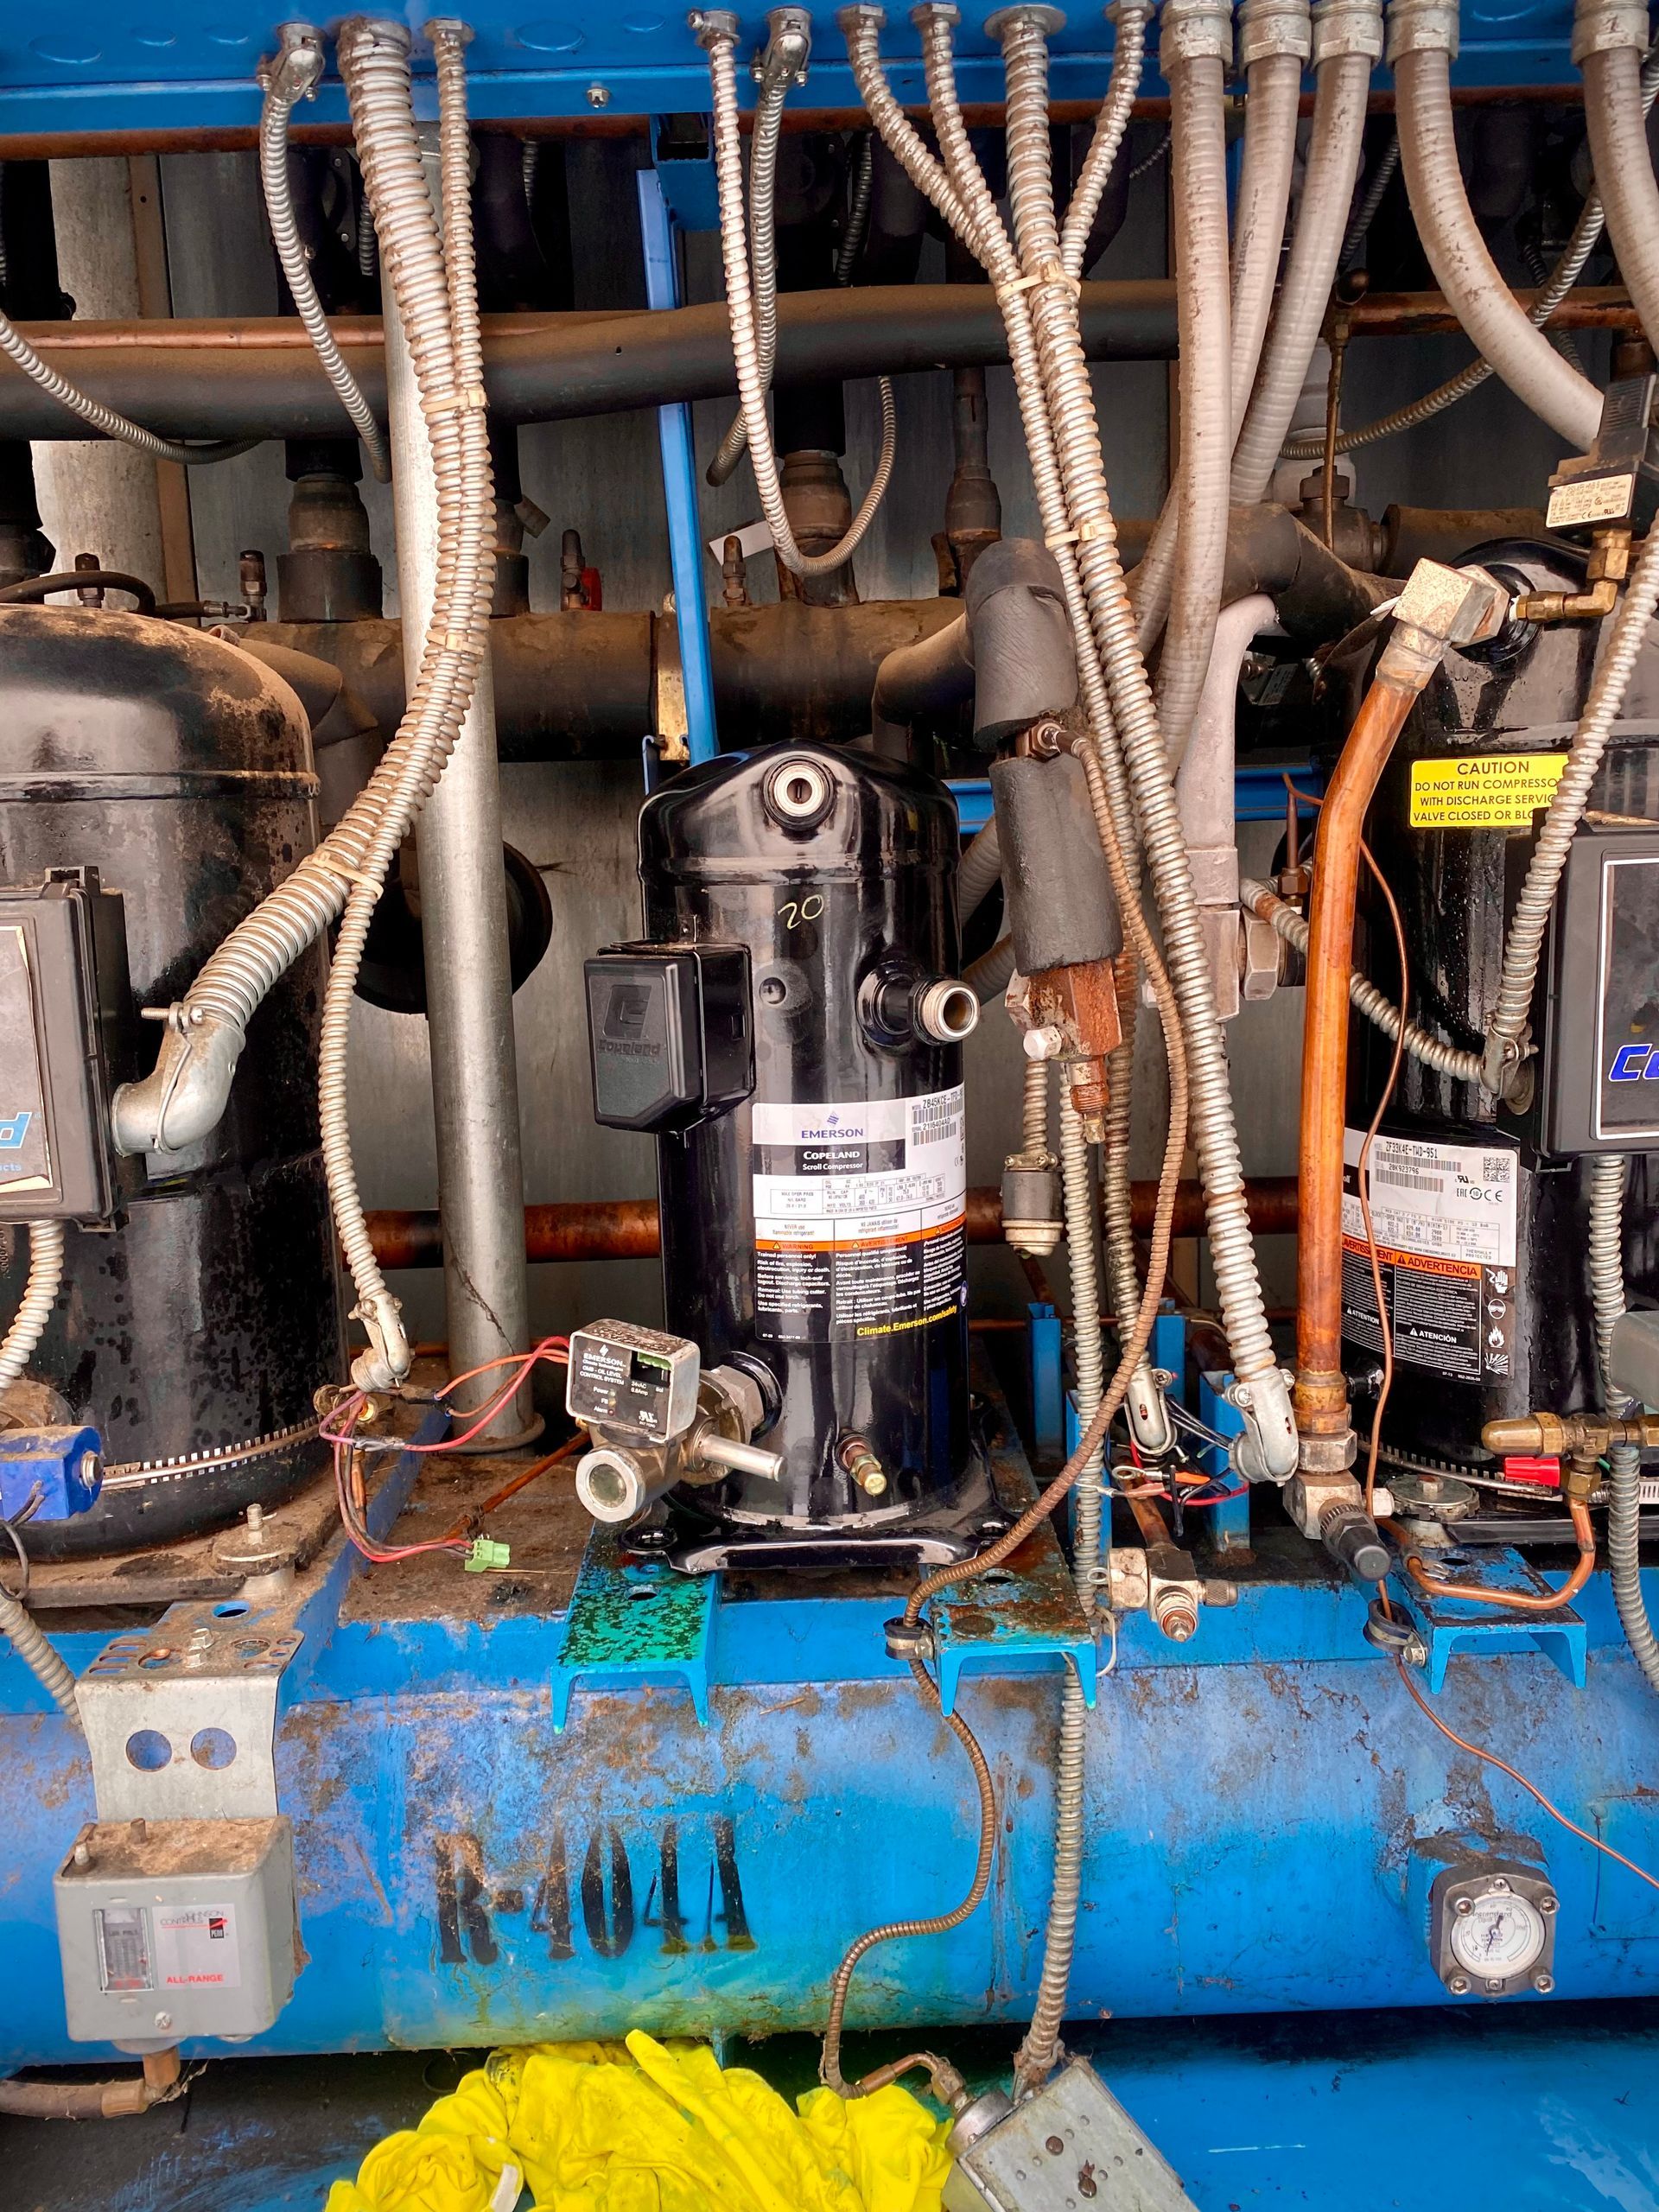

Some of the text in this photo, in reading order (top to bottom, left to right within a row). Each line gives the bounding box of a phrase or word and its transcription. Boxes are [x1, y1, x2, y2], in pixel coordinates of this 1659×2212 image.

[1457, 760, 1529, 775] CAUTION
[1415, 778, 1560, 791] DO NOT RUN COMPRESSO
[1421, 794, 1555, 806] WITH DISCHARGE SERVIC
[1414, 811, 1445, 821] VALVE
[1447, 810, 1491, 821] CLOSED
[1494, 810, 1511, 819] OR
[778, 894, 823, 930] 20
[801, 1128, 863, 1138] EMERSON
[823, 1162, 864, 1171] Compressor
[1408, 1257, 1478, 1276] ADVERTENCIA
[856, 1305, 957, 1336] Climate.Emerson.com/safety
[1352, 1309, 1380, 1325] ATTENTION
[1419, 1331, 1457, 1344] ATENCIÓN
[583, 1353, 623, 1366] EMERSON
[580, 1370, 625, 1386] CONTROL SYSTEM
[607, 1370, 622, 1379] LEVEL
[593, 1386, 609, 1395] Power
[435, 1813, 757, 1966] R-404A
[166, 1974, 224, 1985] ALL-RANGE
